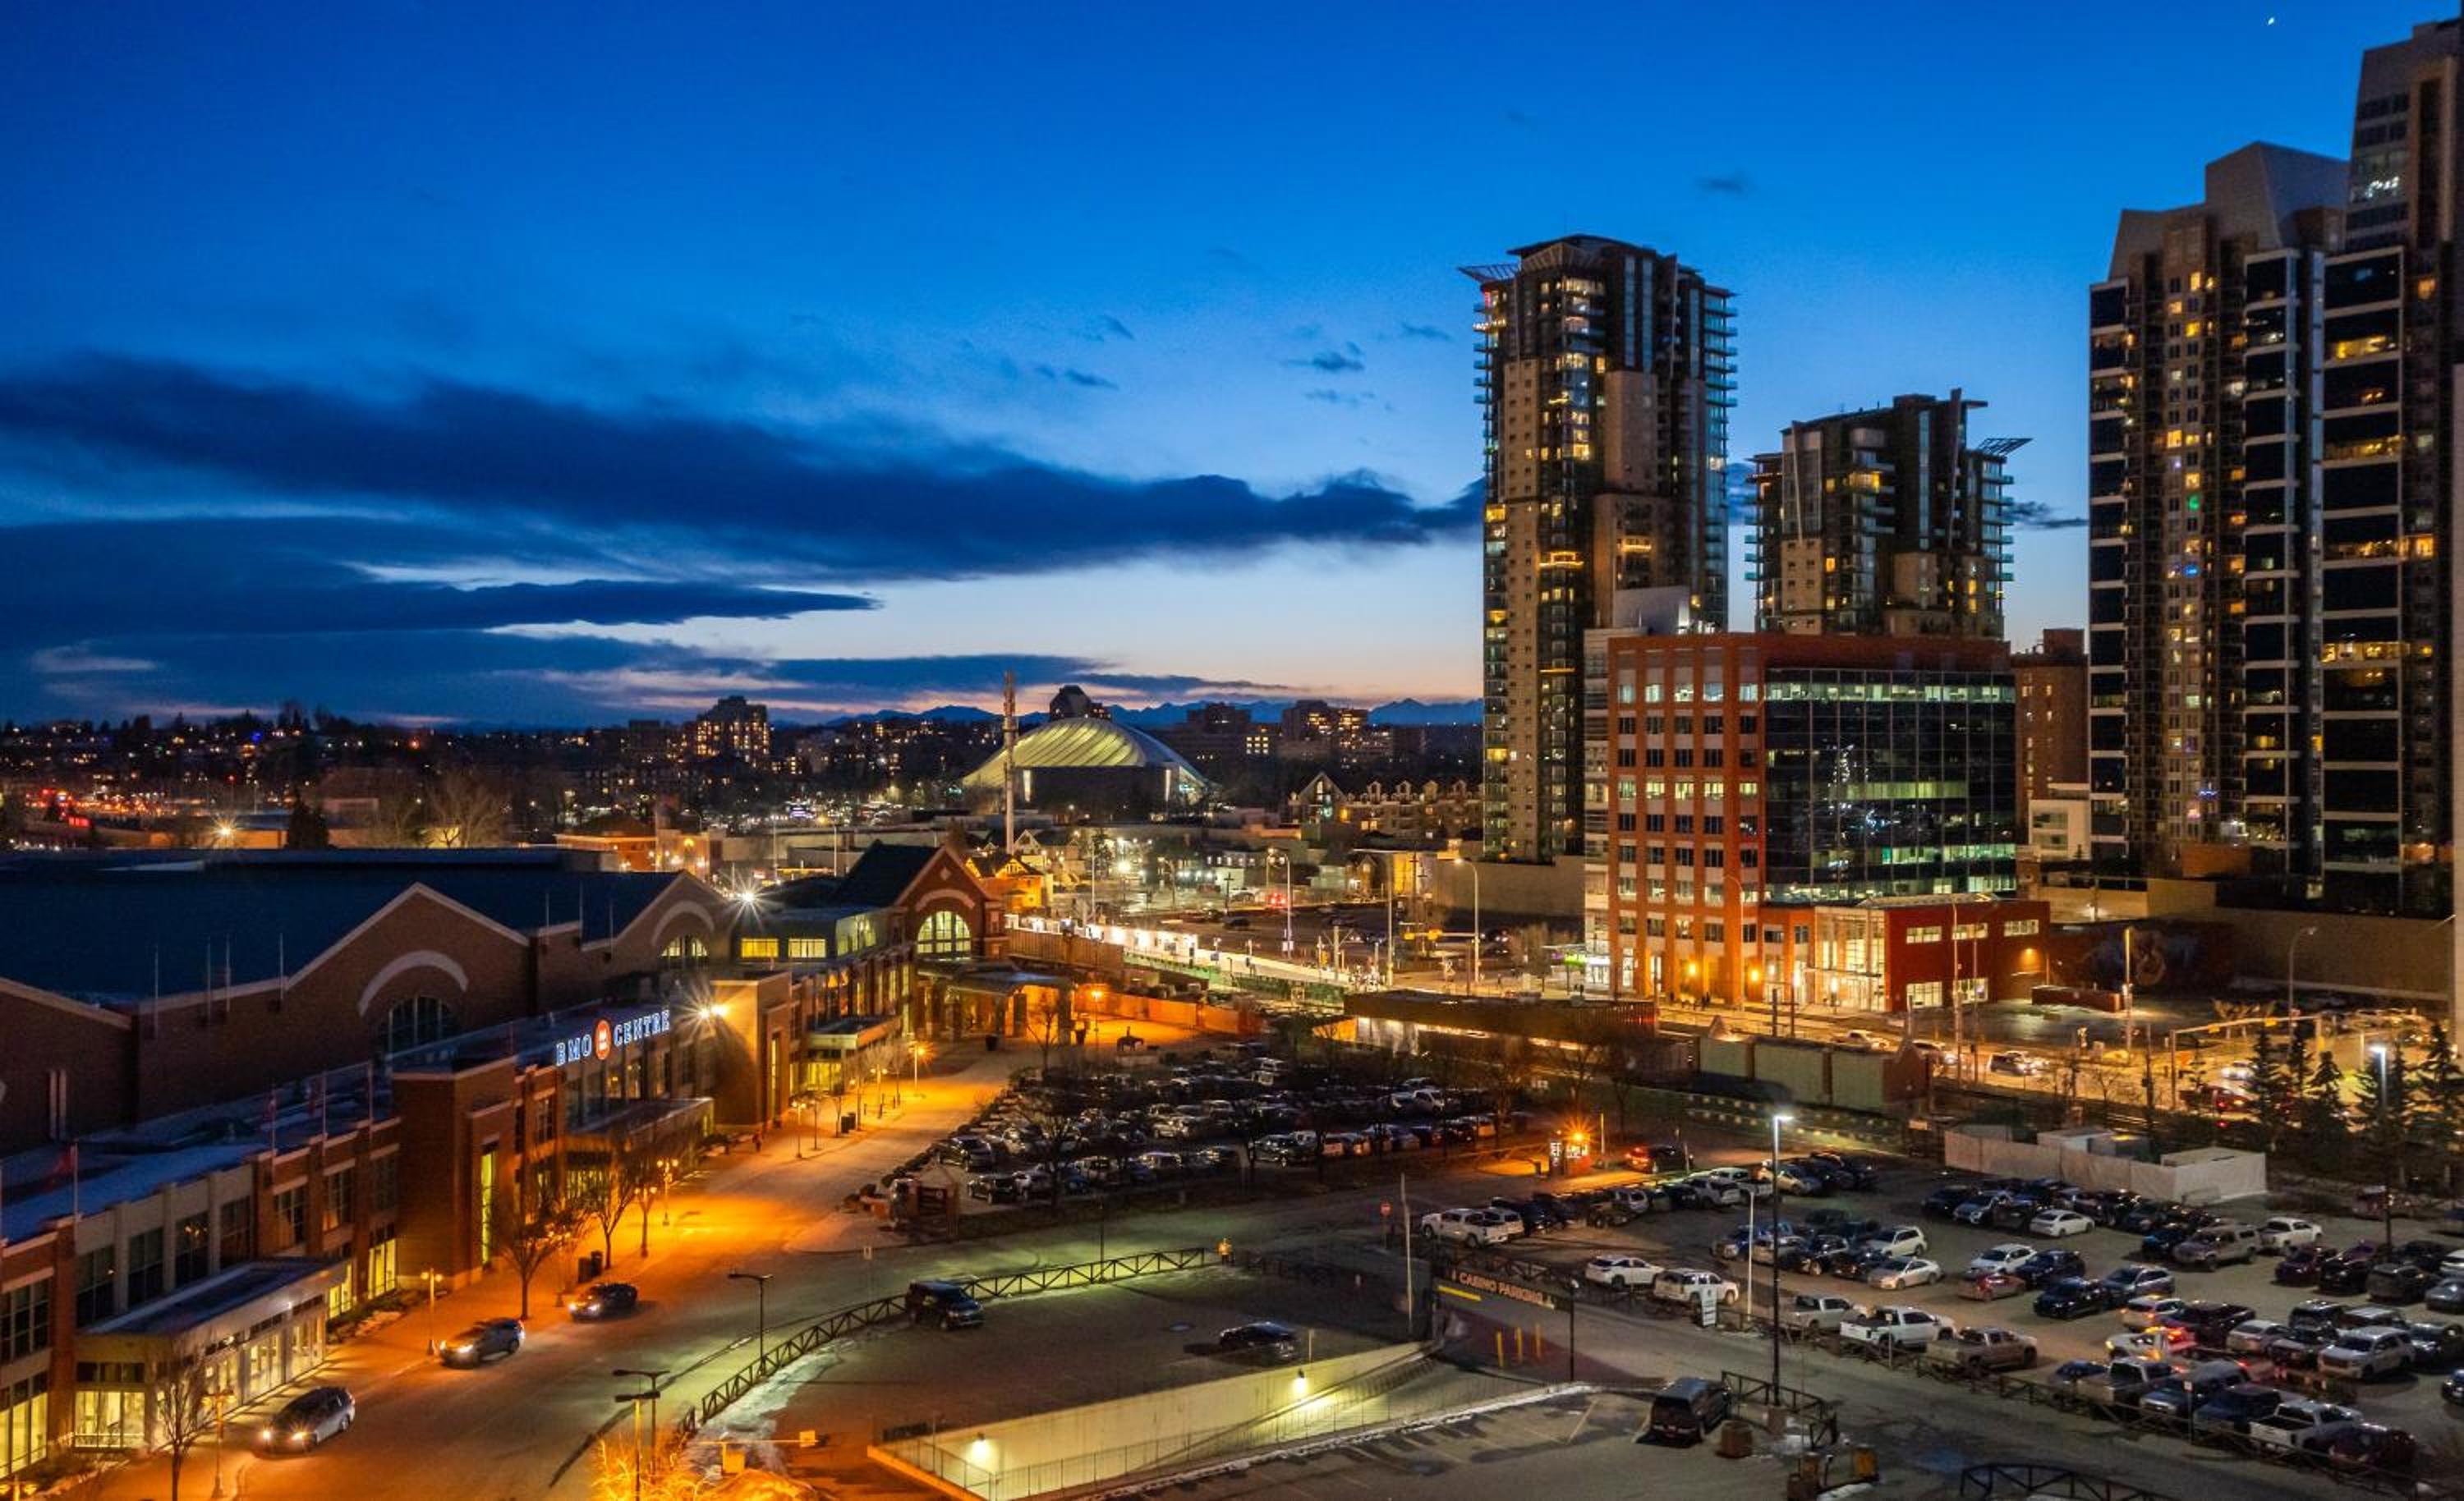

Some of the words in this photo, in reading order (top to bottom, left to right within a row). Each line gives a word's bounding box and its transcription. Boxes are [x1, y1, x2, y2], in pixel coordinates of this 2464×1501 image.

[556, 1034, 592, 1067] BMO
[614, 1009, 670, 1047] CENTRE
[1460, 1272, 1497, 1292] CASINO
[1497, 1282, 1544, 1305] PARKING
